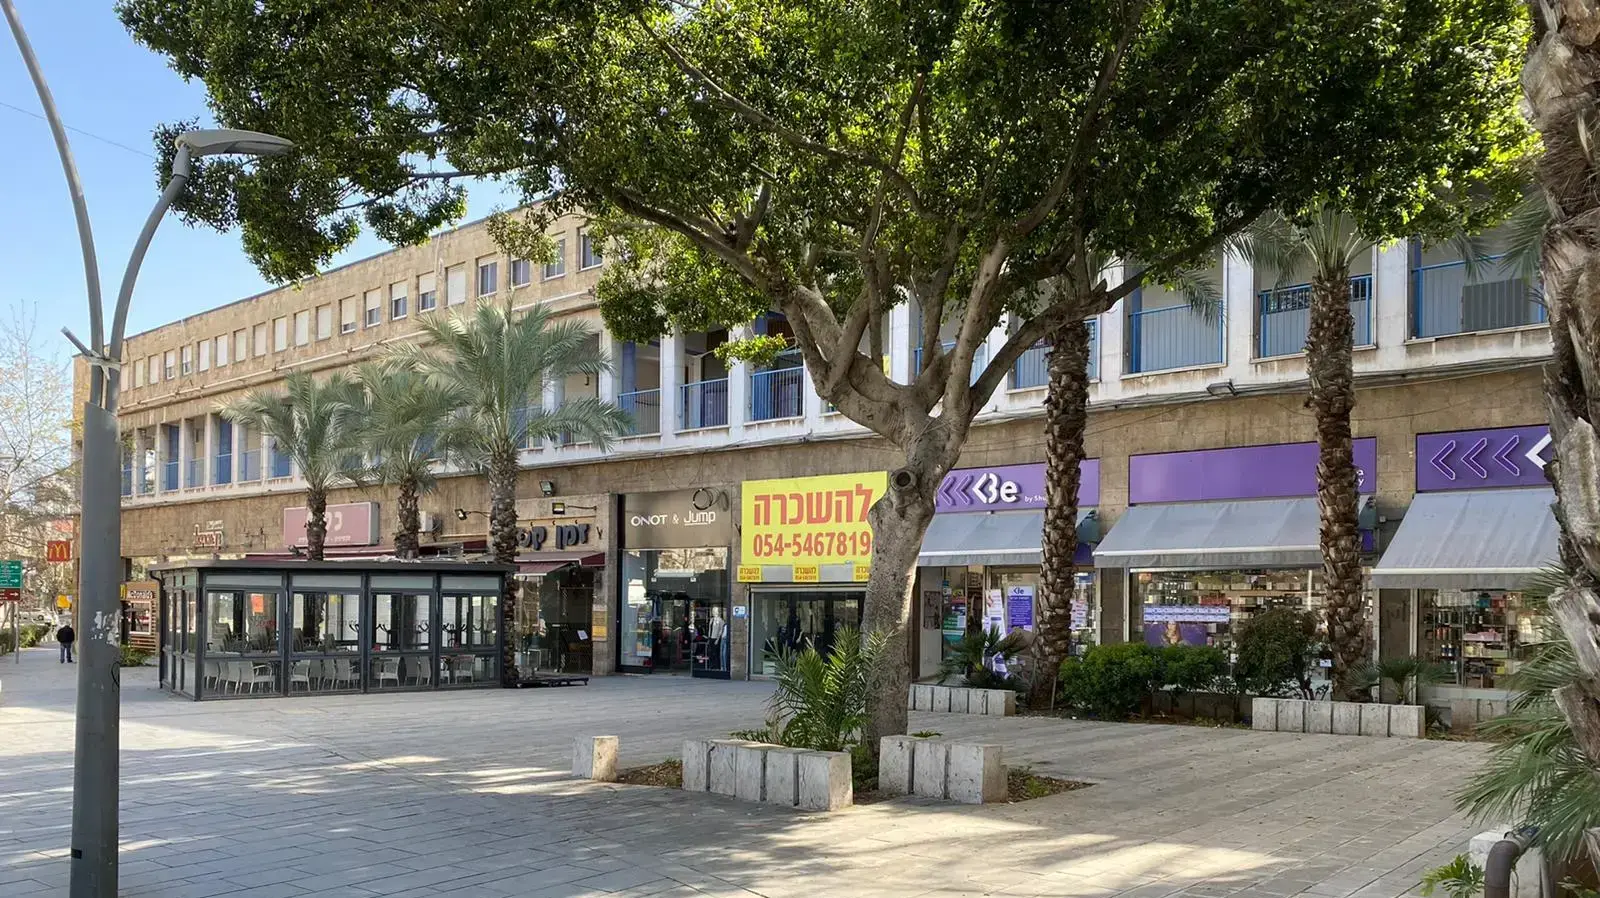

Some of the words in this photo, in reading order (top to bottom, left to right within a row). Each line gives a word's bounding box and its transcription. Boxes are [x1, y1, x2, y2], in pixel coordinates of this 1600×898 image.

[754, 483, 874, 526] להשכרה
[630, 514, 668, 527] ONOT
[672, 514, 680, 525] &
[683, 510, 716, 526] Jump
[516, 526, 547, 551] קפ
[555, 524, 590, 550] זמן
[753, 530, 871, 557] 054-5467819
